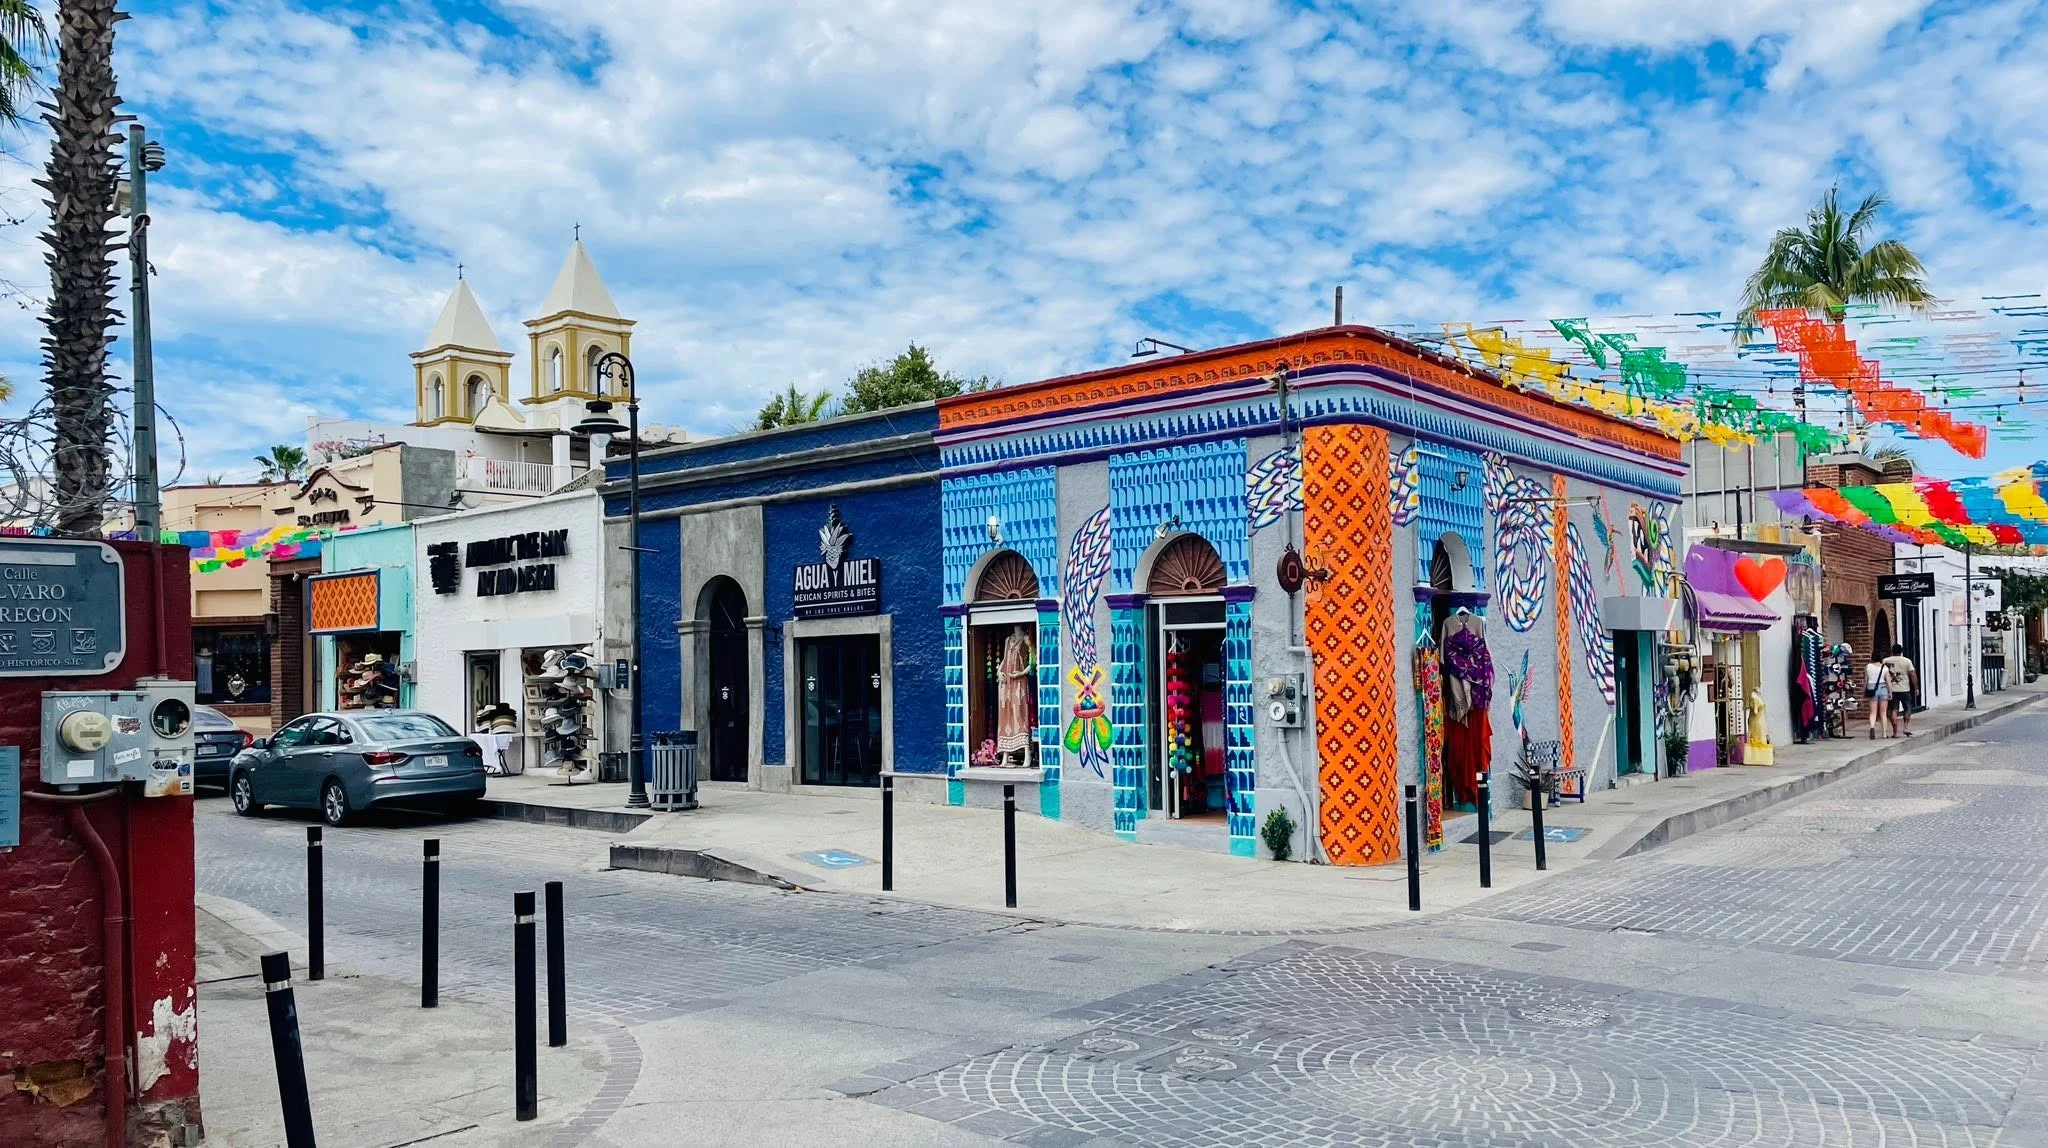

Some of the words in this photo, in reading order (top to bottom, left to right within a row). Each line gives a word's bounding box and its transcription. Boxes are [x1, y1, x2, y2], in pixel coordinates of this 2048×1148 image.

[4, 567, 38, 580] Calle
[795, 563, 829, 591] AGUA
[832, 570, 838, 587] Y
[843, 559, 876, 587] MIEL
[794, 592, 822, 603] MEXICAN
[823, 589, 848, 600] SPIRITS
[850, 589, 855, 598] &
[856, 587, 876, 597] BITES
[7, 658, 61, 667] HISTORICO
